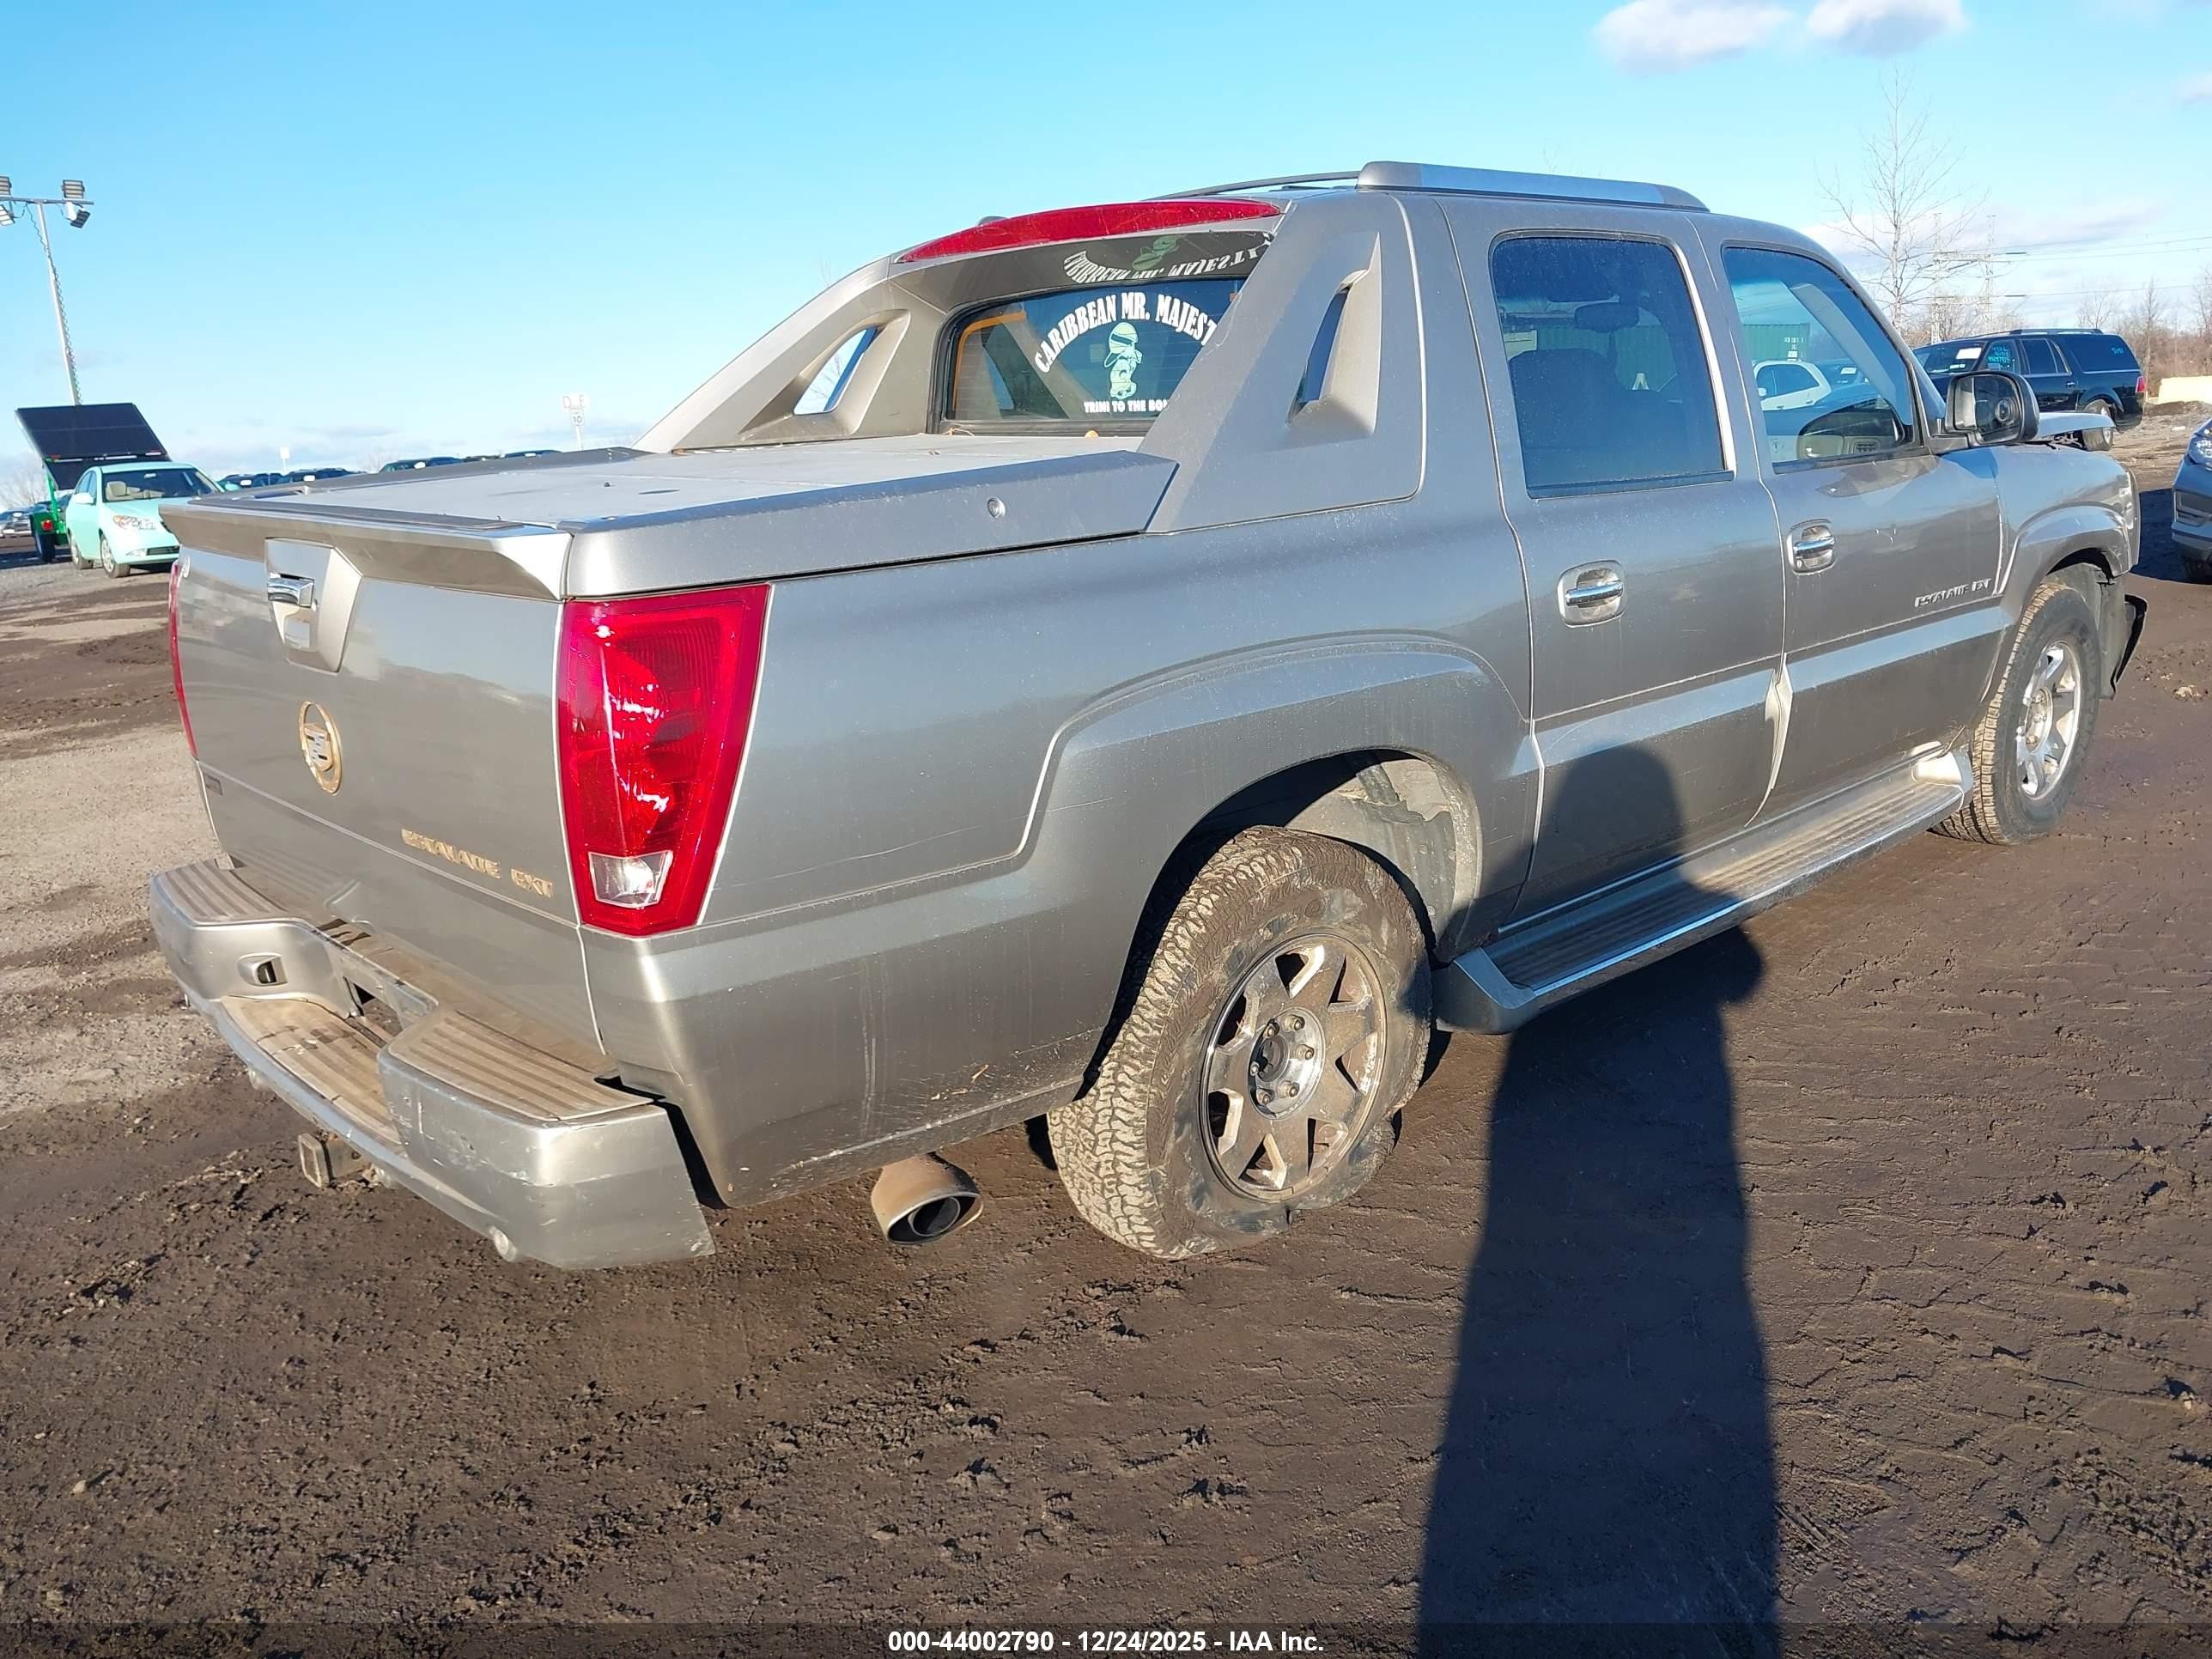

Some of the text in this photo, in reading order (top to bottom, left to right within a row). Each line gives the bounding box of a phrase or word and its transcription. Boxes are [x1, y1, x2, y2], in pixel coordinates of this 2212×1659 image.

[1035, 295, 1116, 373] CARIBBEAN
[1121, 292, 1151, 320] MR.
[1084, 400, 1110, 413] TRINI
[1112, 400, 1126, 412] TO
[1127, 399, 1146, 412] THE
[401, 829, 554, 898] ESCALADE EXT
